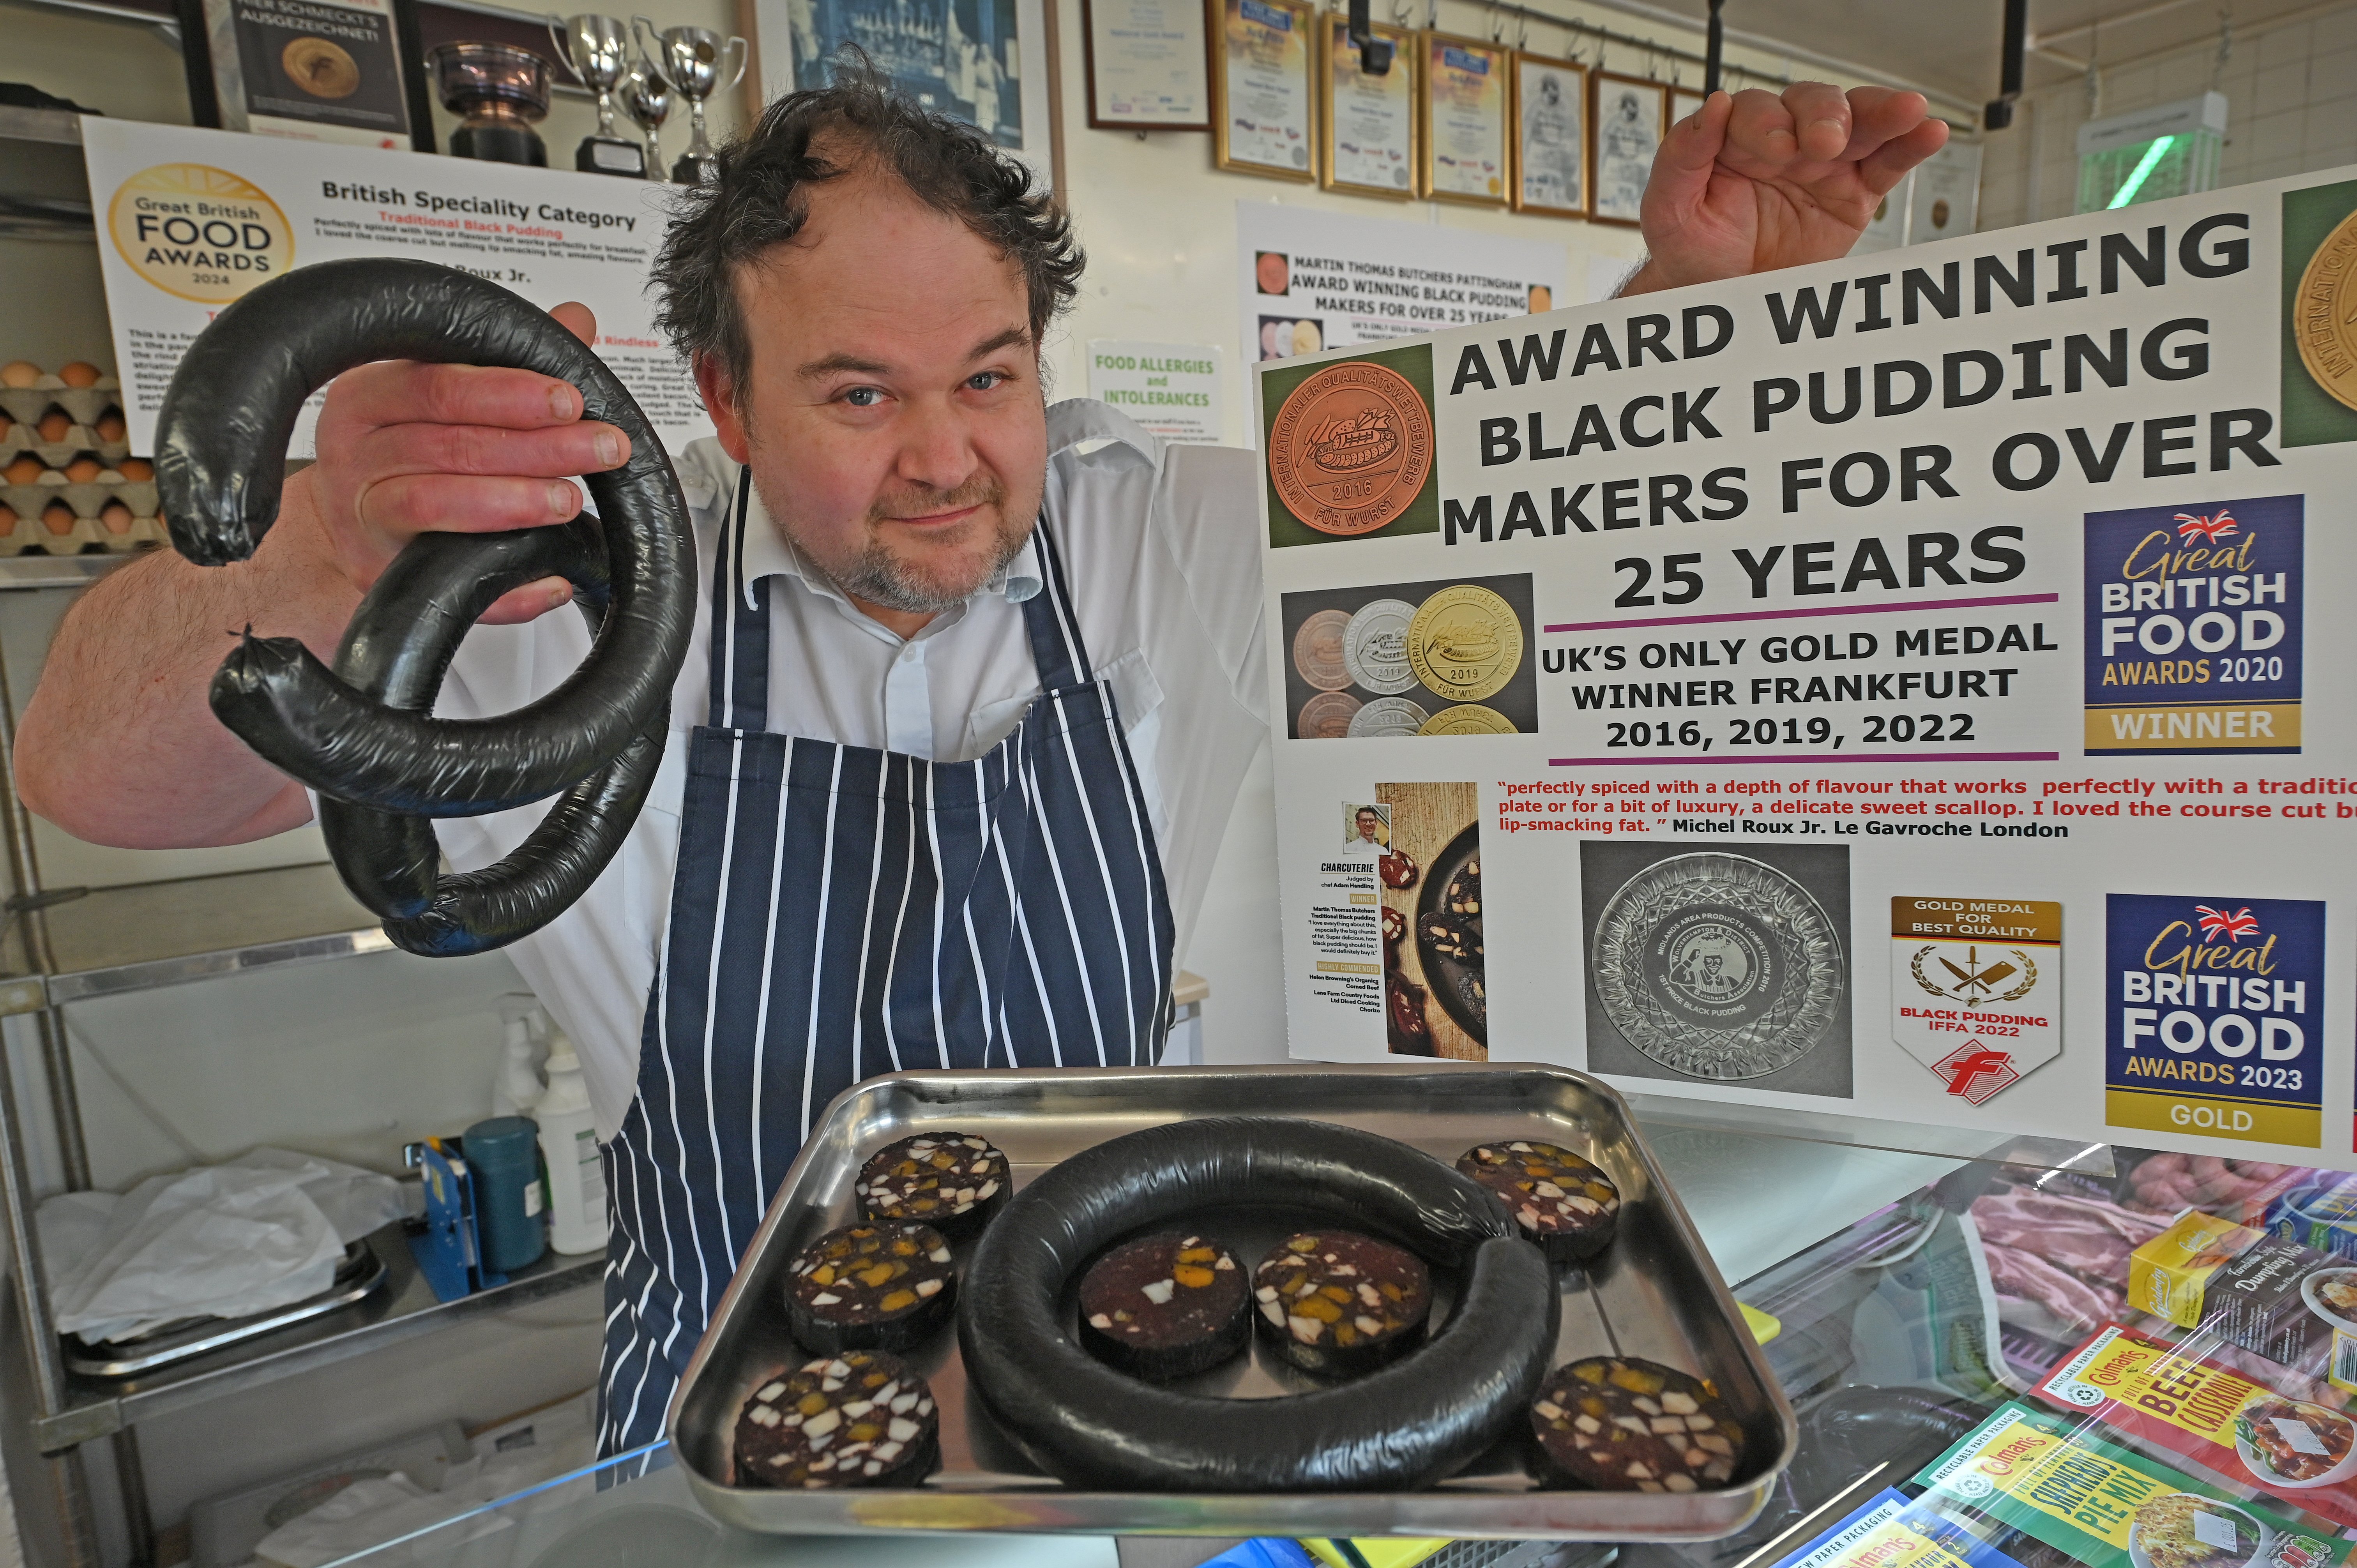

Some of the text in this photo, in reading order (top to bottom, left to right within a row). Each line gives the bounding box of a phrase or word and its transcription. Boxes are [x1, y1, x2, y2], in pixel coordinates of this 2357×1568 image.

[135, 196, 260, 220] Great British
[322, 180, 636, 232] British Speciality Category
[136, 214, 270, 250] FOOD
[378, 210, 563, 240] Traditional Black Pudding
[145, 247, 270, 272] AWARDS
[193, 272, 230, 284] 2024
[1291, 274, 1525, 309] AWARD WINNING BLACK PUDDING
[1450, 213, 2250, 395] AWARD WINNING
[1095, 355, 1213, 374] FOOD ALLERGIES
[1147, 375, 1168, 386] and
[1104, 390, 1209, 406] INTOLERANCES
[1479, 317, 2209, 468] BLACK PUDDING
[1276, 370, 1425, 504] INTERNATIONALER QUALITÄTSWETTBEWERB
[1332, 480, 1373, 500] 2016
[1444, 408, 2282, 546] MAKERS FOR OVER
[1314, 496, 1396, 527] FÜR WURST
[1615, 526, 2025, 607] 25 YEARS
[2122, 530, 2256, 590] Great
[2102, 572, 2286, 613] BRITISH
[1640, 639, 1746, 668] ONLY
[1761, 633, 1877, 663] GOLD
[1896, 623, 2058, 657] MEDAL
[2102, 610, 2285, 656] FOOD
[2102, 656, 2282, 686] AWARDS 2020
[1571, 669, 2018, 710] WINNER FRANKFURT
[1608, 714, 1974, 751] 2016, 2019, 2022
[2111, 711, 2275, 739] WINNER
[1592, 780, 1649, 796] spiced
[1657, 780, 1698, 793] with
[1706, 783, 1716, 793] a
[1724, 780, 1781, 796] depth
[1789, 780, 1809, 793] of
[1816, 780, 1893, 793] flavour
[1900, 779, 1947, 793] that
[1954, 779, 2027, 793] works
[2043, 779, 2155, 797] perfectly
[2164, 779, 2222, 793] with
[2233, 782, 2247, 793] a
[1500, 800, 1542, 814] plate
[1548, 803, 1566, 812] or
[1572, 800, 1597, 812] for
[1604, 803, 1613, 812] a
[1623, 800, 1645, 812] bit
[1652, 800, 1670, 812] of
[1677, 800, 1744, 816] luxury,
[1752, 803, 1763, 813] a
[1770, 800, 1853, 814] delicate
[1861, 801, 1927, 814] sweet
[1935, 800, 2023, 818] scallop.
[2034, 801, 2043, 815] I
[2053, 801, 2119, 816] loved
[2129, 801, 2171, 816] the
[2180, 805, 2271, 817] course
[2282, 803, 2326, 818] cut
[1500, 818, 2068, 837] lip-smacking fat. Michel Roux Jr. Le Gavroche London
[1322, 863, 1374, 872] CHARCUTERIE
[1914, 901, 2034, 914] GOLD MEDAL
[1956, 914, 1991, 924] FOR
[1912, 923, 2037, 937] BEST QUALITY
[1341, 964, 1378, 973] COMMENDED
[1658, 913, 1771, 992] MIDLANDS AREA PRODUCTS COMPETITION 2010
[2145, 920, 2280, 984] Great
[1659, 974, 1746, 1016] 1ST PRIZE BLACK PUDDING
[1694, 970, 1754, 1000] Butchers Association
[2124, 971, 2305, 1013] BRITISH
[1900, 1007, 2048, 1027] BLACK PUDDING
[1929, 1021, 2019, 1037] IFFA 2022
[2124, 1007, 2304, 1061] FOOD
[2125, 1056, 2302, 1090] AWARDS 2023
[2171, 1104, 2253, 1131] GOLD
[2235, 1256, 2296, 1291] Dumpling
[2277, 1244, 2308, 1259] Mix
[2150, 1268, 2172, 1317] Goldenfry
[2049, 1328, 2120, 1391] RECYCLABLE PAPER PACKAGING
[2137, 1360, 2207, 1417] BEEF
[2177, 1374, 2253, 1432] CASSEROLE
[1936, 1411, 2021, 1480] RECYCLABLE PAPER PACKAGING
[2074, 1470, 2157, 1534] PIE MIX
[1815, 1508, 1893, 1562] PAPER PACKAGING
